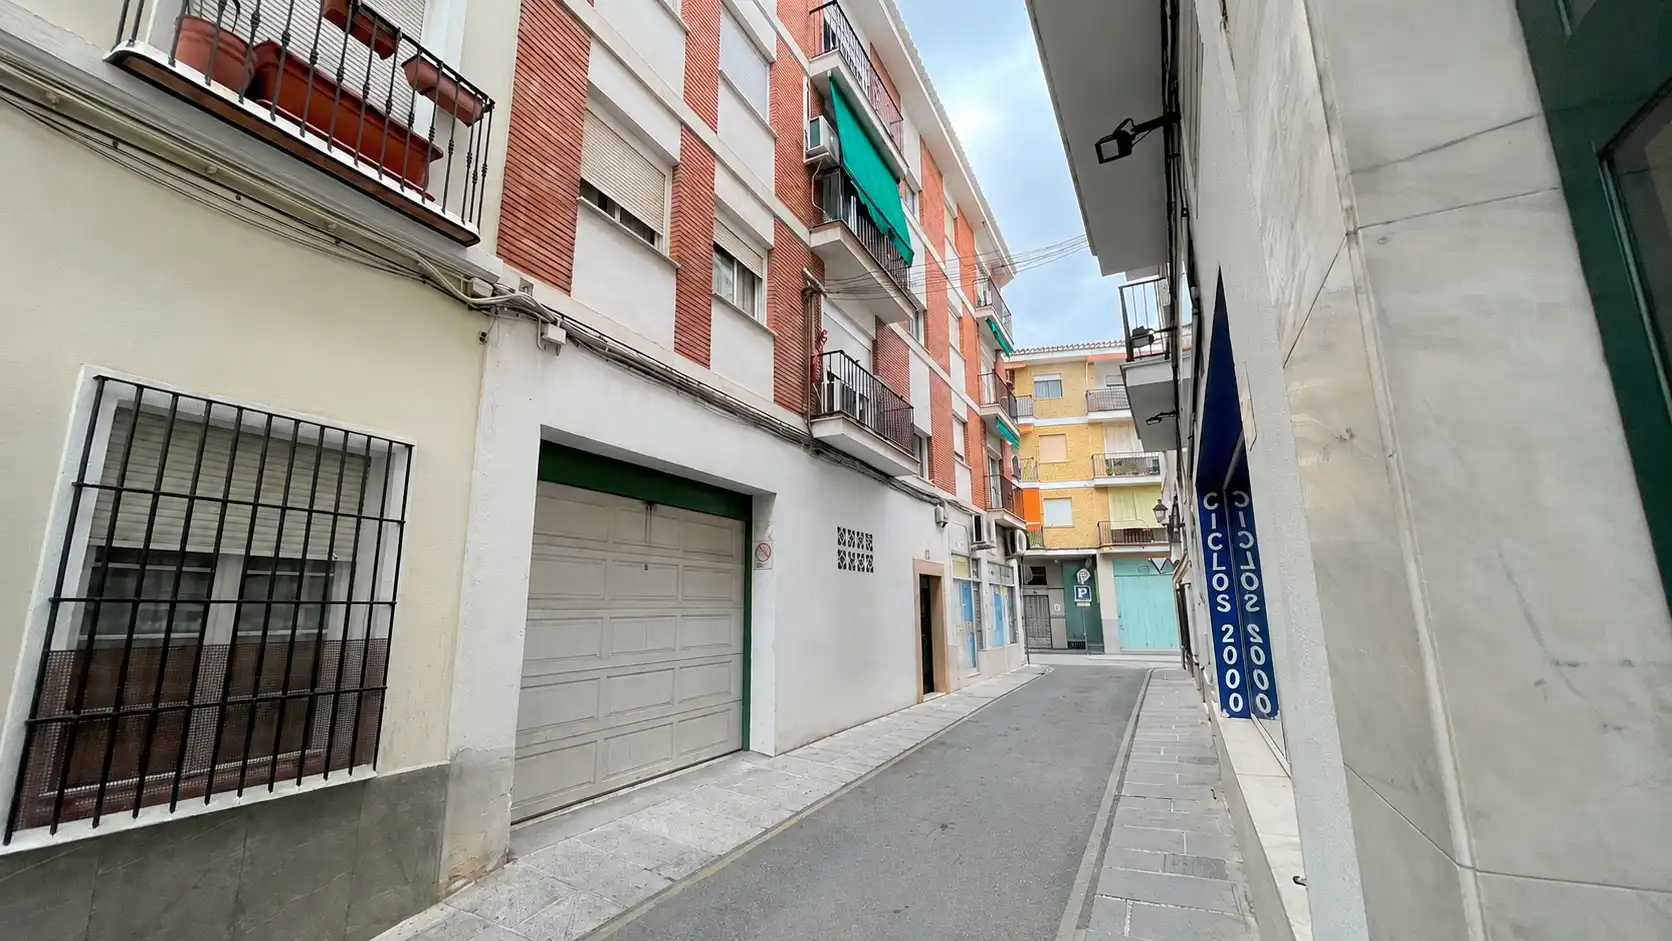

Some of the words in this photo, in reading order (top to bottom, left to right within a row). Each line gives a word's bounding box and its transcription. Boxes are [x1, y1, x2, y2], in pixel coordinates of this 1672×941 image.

[1077, 587, 1088, 598] P
[1203, 492, 1232, 612] CICLOS
[1221, 624, 1244, 712] 2000
